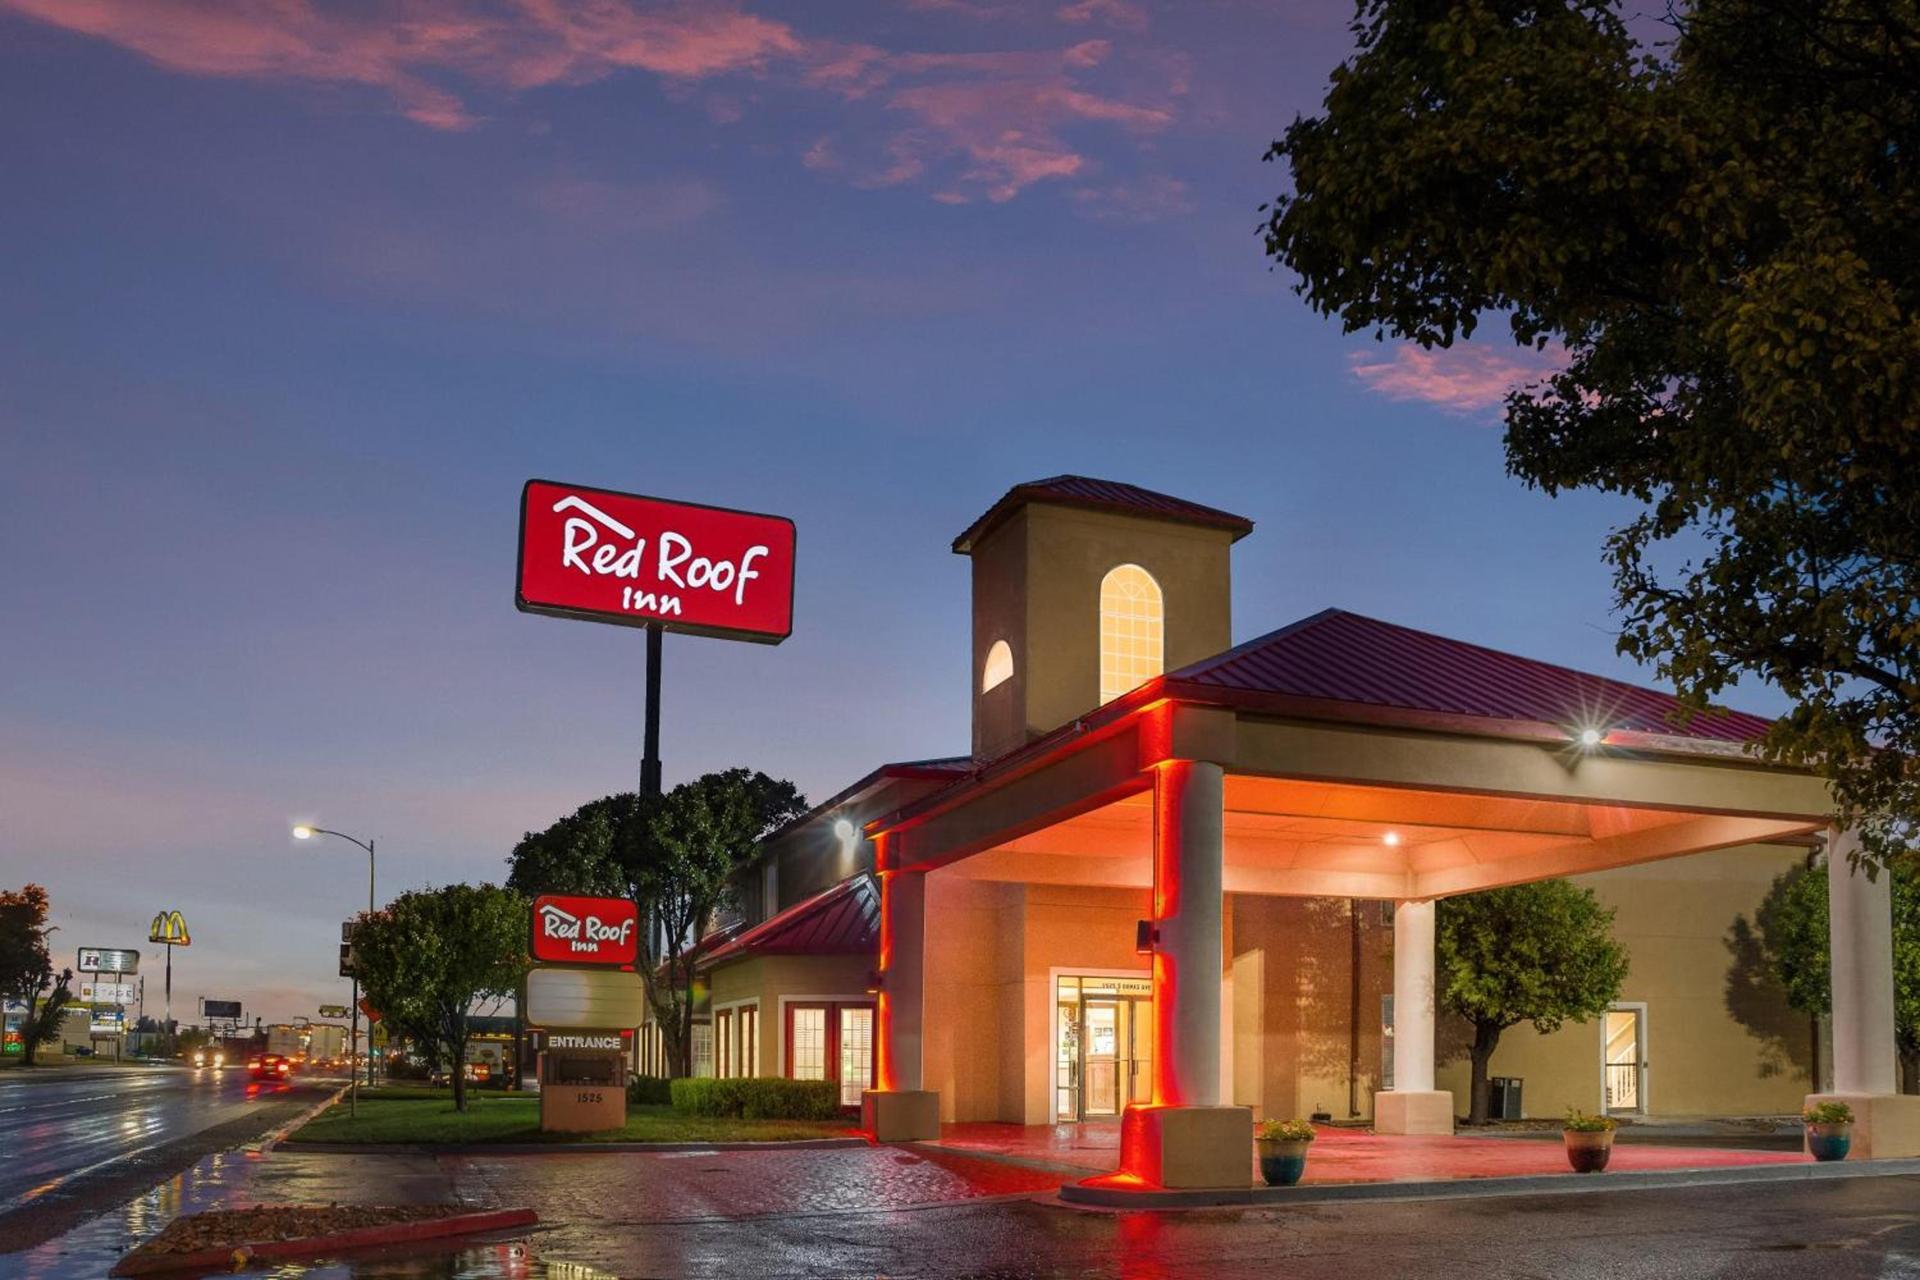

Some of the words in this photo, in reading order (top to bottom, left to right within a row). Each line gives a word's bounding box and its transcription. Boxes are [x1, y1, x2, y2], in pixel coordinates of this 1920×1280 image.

[563, 517, 646, 579] Red
[658, 531, 769, 606] Roof
[622, 586, 682, 616] Inn
[545, 914, 581, 939] Red
[585, 916, 634, 946] Roof
[548, 1036, 621, 1049] ENTRANCE
[577, 1092, 603, 1104] 1525
